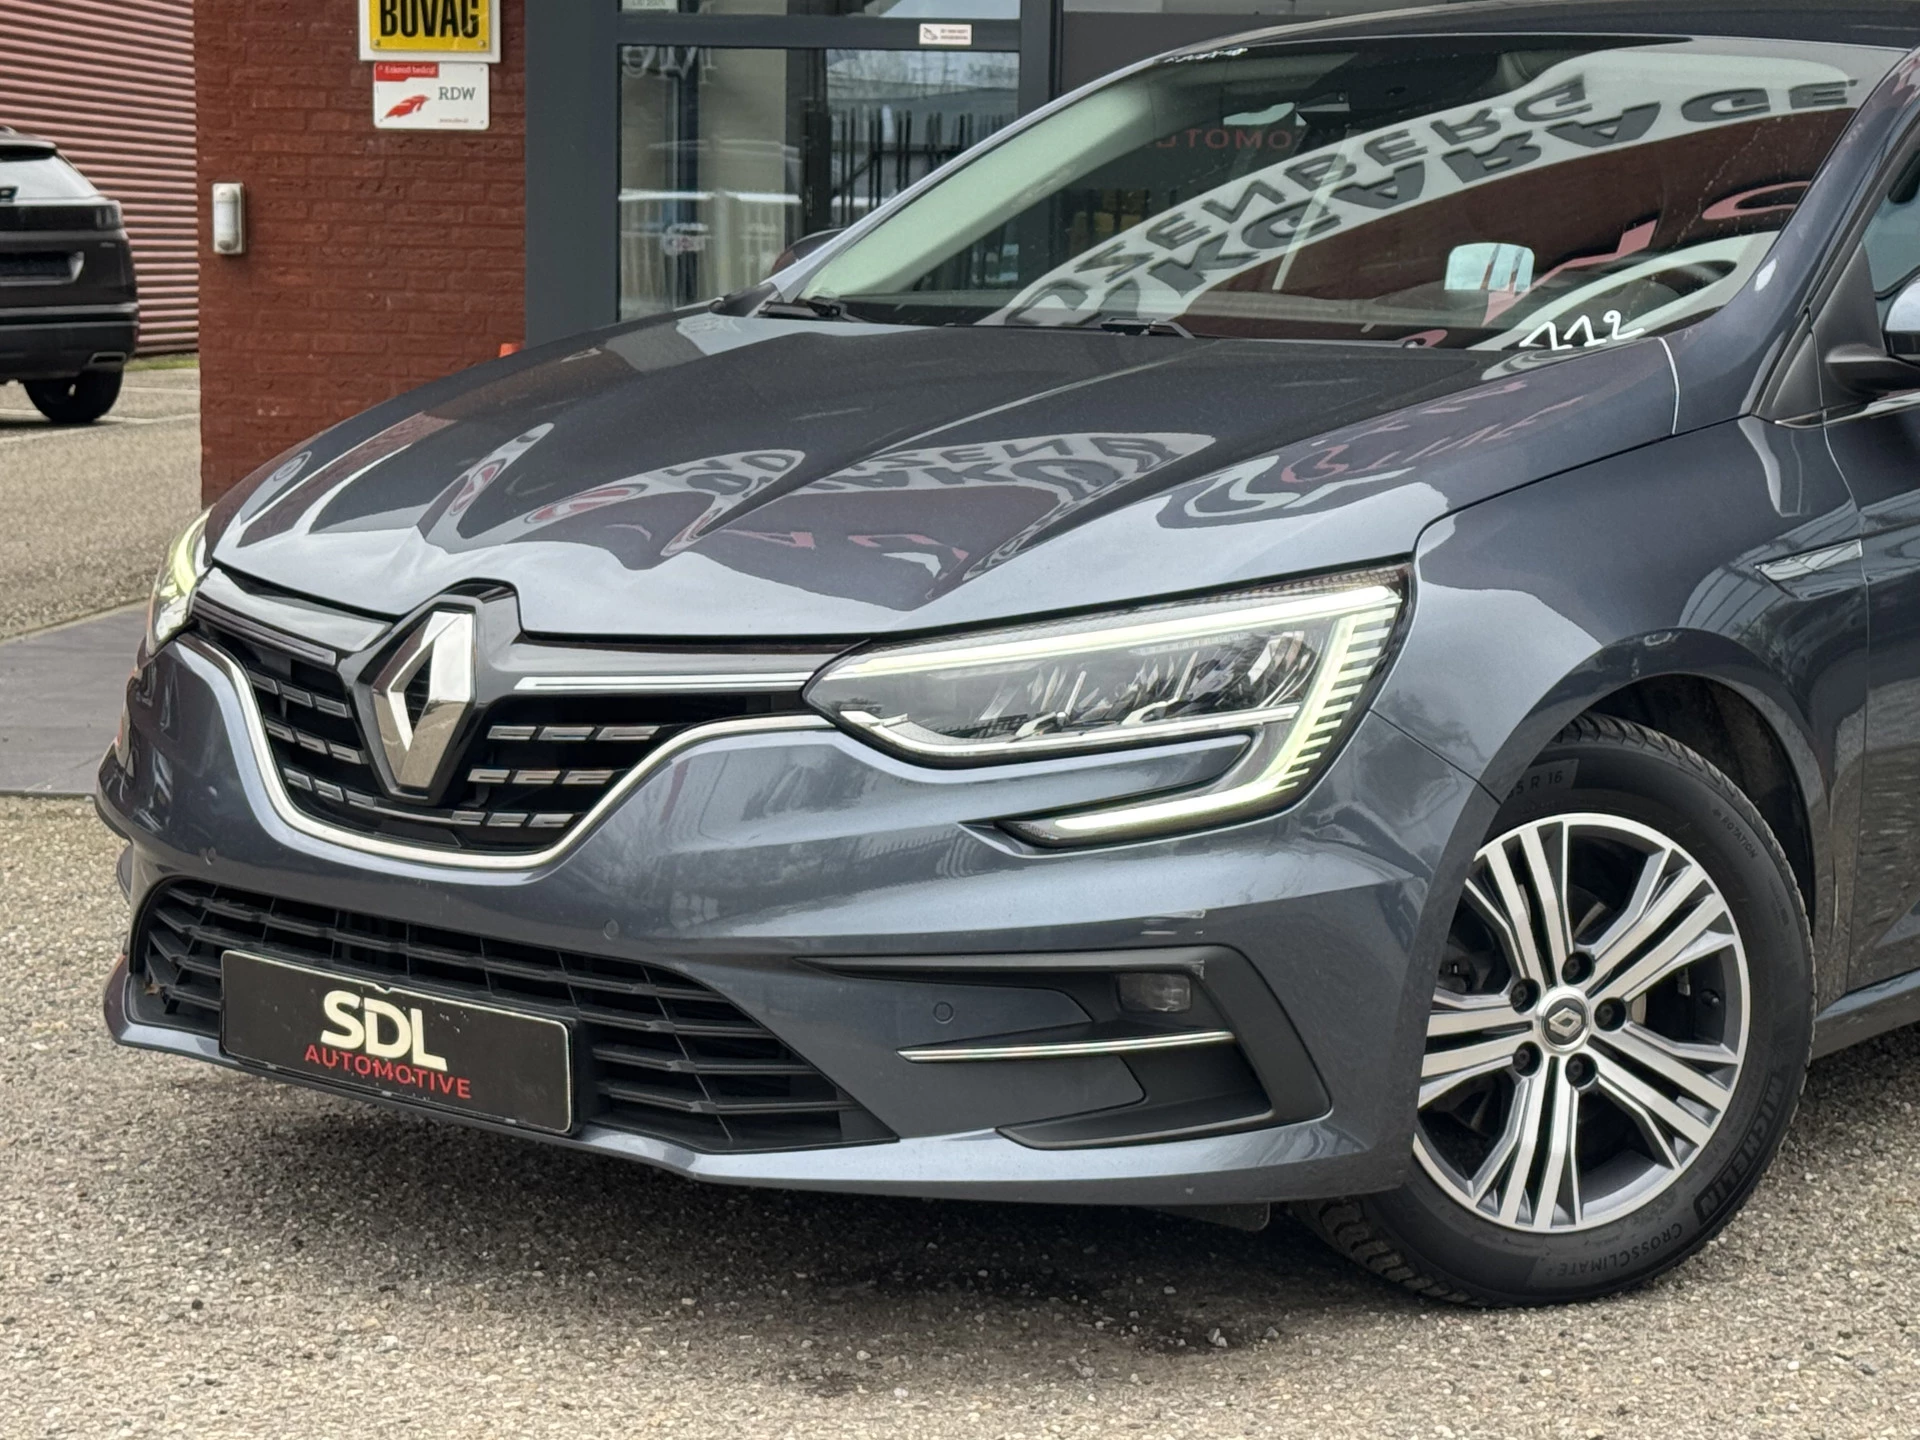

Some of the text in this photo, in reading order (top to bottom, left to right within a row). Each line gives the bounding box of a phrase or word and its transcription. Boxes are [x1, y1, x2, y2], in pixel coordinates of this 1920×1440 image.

[380, 0, 480, 38] BOVAG
[438, 86, 476, 101] RDW
[1519, 310, 1645, 351] 112
[1547, 770, 1563, 785] 16
[1720, 815, 1758, 858] ROTATION
[320, 990, 448, 1072] SDL
[304, 1044, 472, 1099] AUTOMOTIVE
[1700, 1075, 1784, 1218] MICHELIN
